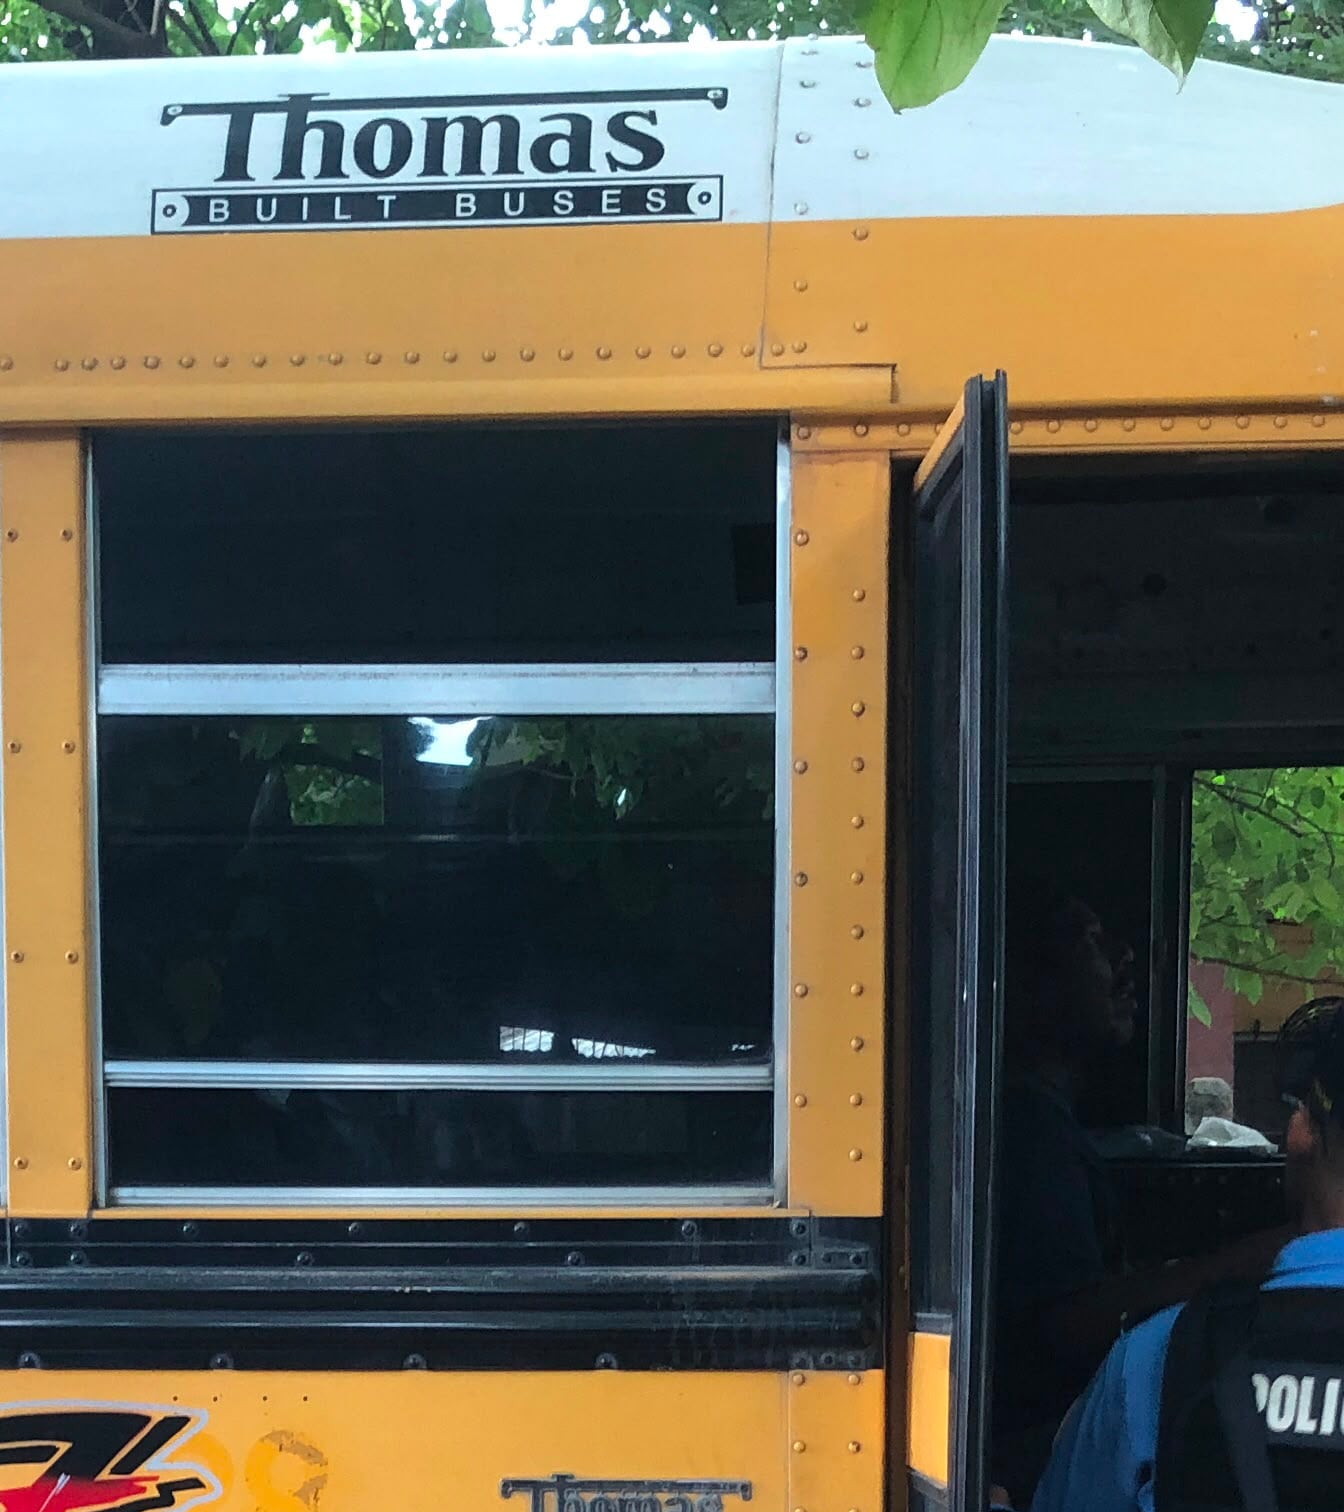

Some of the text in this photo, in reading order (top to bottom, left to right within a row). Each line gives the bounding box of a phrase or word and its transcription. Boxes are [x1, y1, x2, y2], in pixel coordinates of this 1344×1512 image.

[161, 89, 727, 182] Thomas
[208, 187, 668, 223] BUILT BUSES
